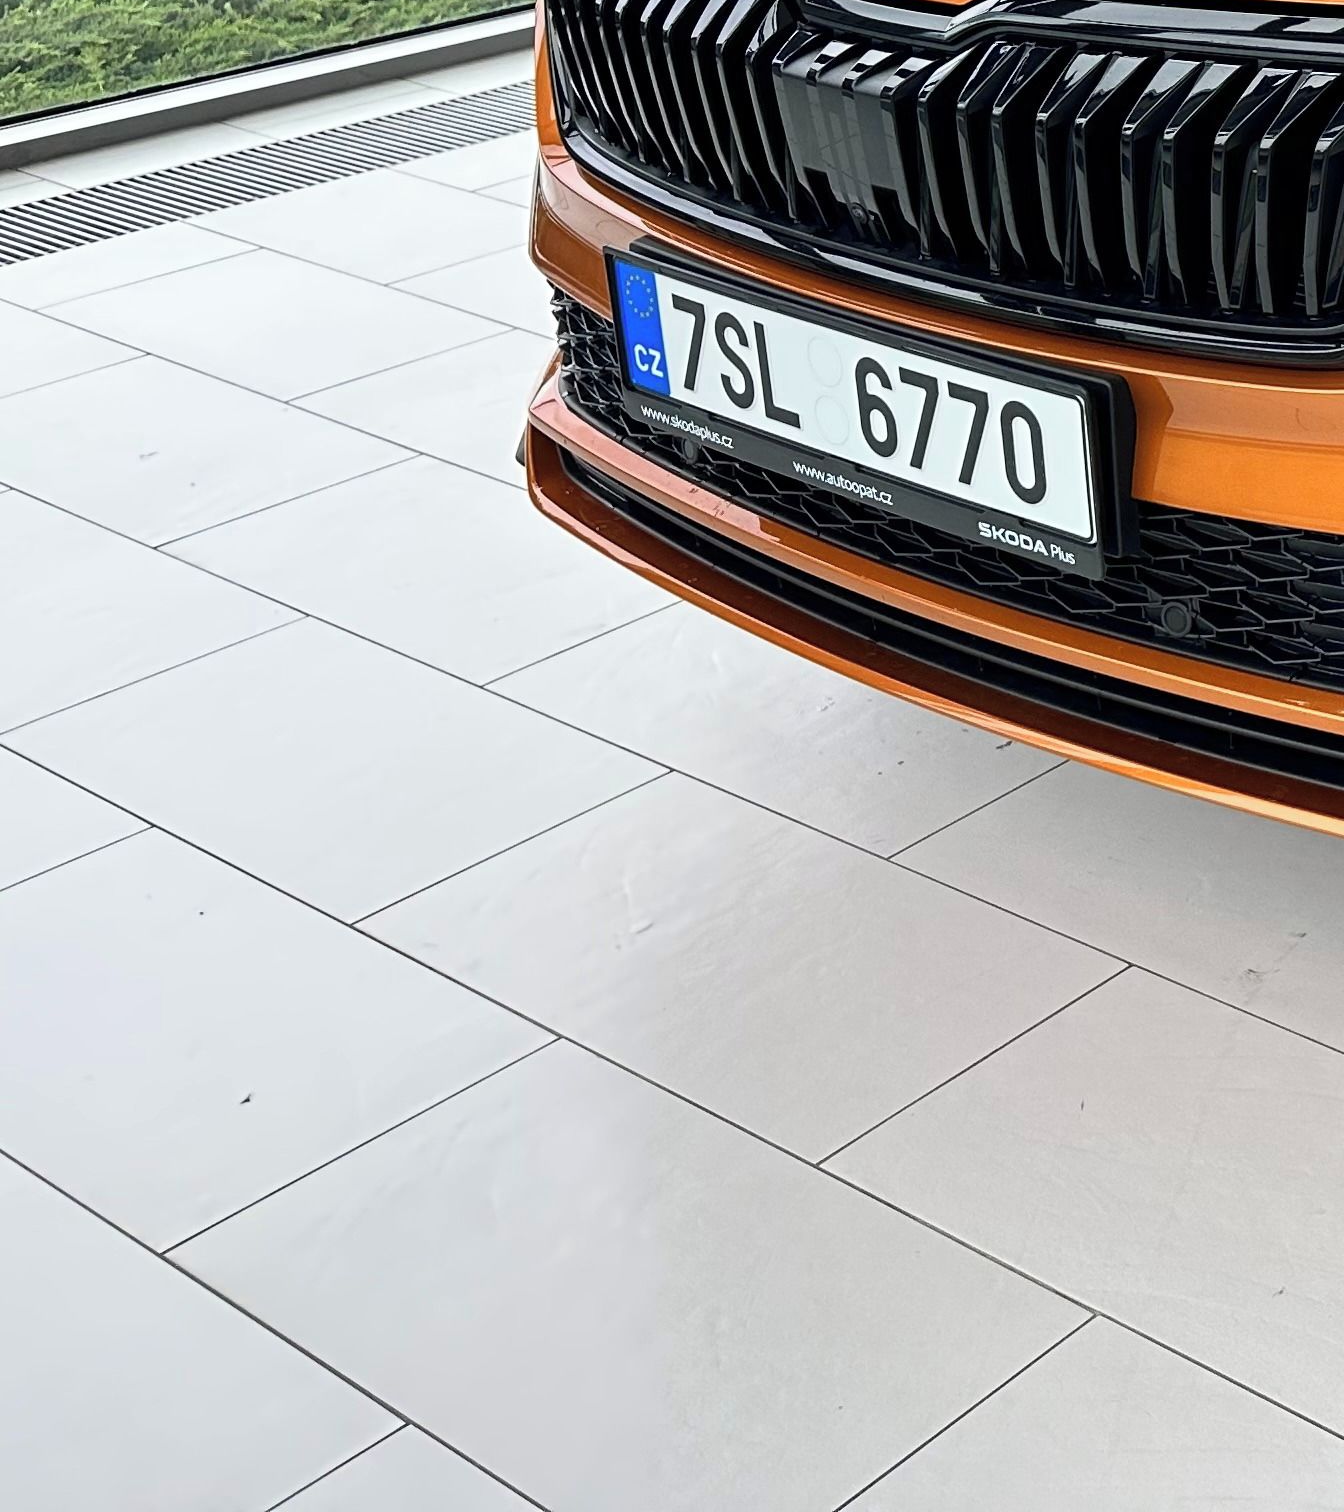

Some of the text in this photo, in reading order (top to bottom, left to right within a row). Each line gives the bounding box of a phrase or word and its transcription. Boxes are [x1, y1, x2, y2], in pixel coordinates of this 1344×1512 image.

[634, 343, 664, 378] CZ
[672, 293, 1047, 504] 7SL 6770
[640, 404, 735, 449] www.skodaplus.cz
[792, 460, 894, 506] www.autoopat.cz
[1050, 543, 1076, 565] Plus
